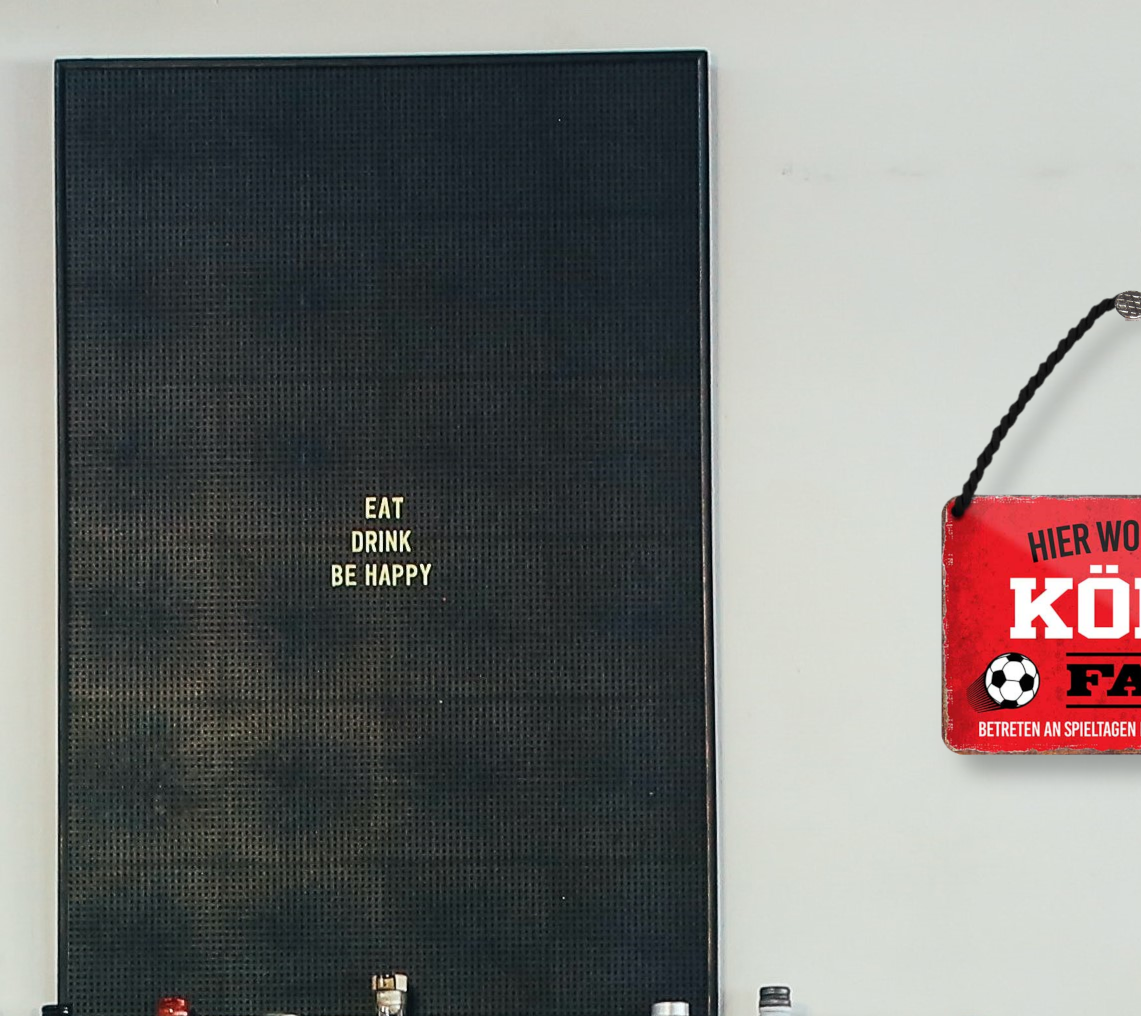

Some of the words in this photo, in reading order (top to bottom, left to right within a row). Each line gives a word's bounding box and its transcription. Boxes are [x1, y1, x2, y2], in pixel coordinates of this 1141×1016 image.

[366, 497, 403, 519] EAT
[352, 530, 411, 552] DRINK
[1028, 524, 1089, 563] HIER
[332, 564, 356, 586] BE
[366, 564, 431, 586] HAPPY
[978, 721, 1040, 738] BETRETEN
[1044, 721, 1061, 738] AN
[1064, 721, 1136, 738] SPIELTAGEN
